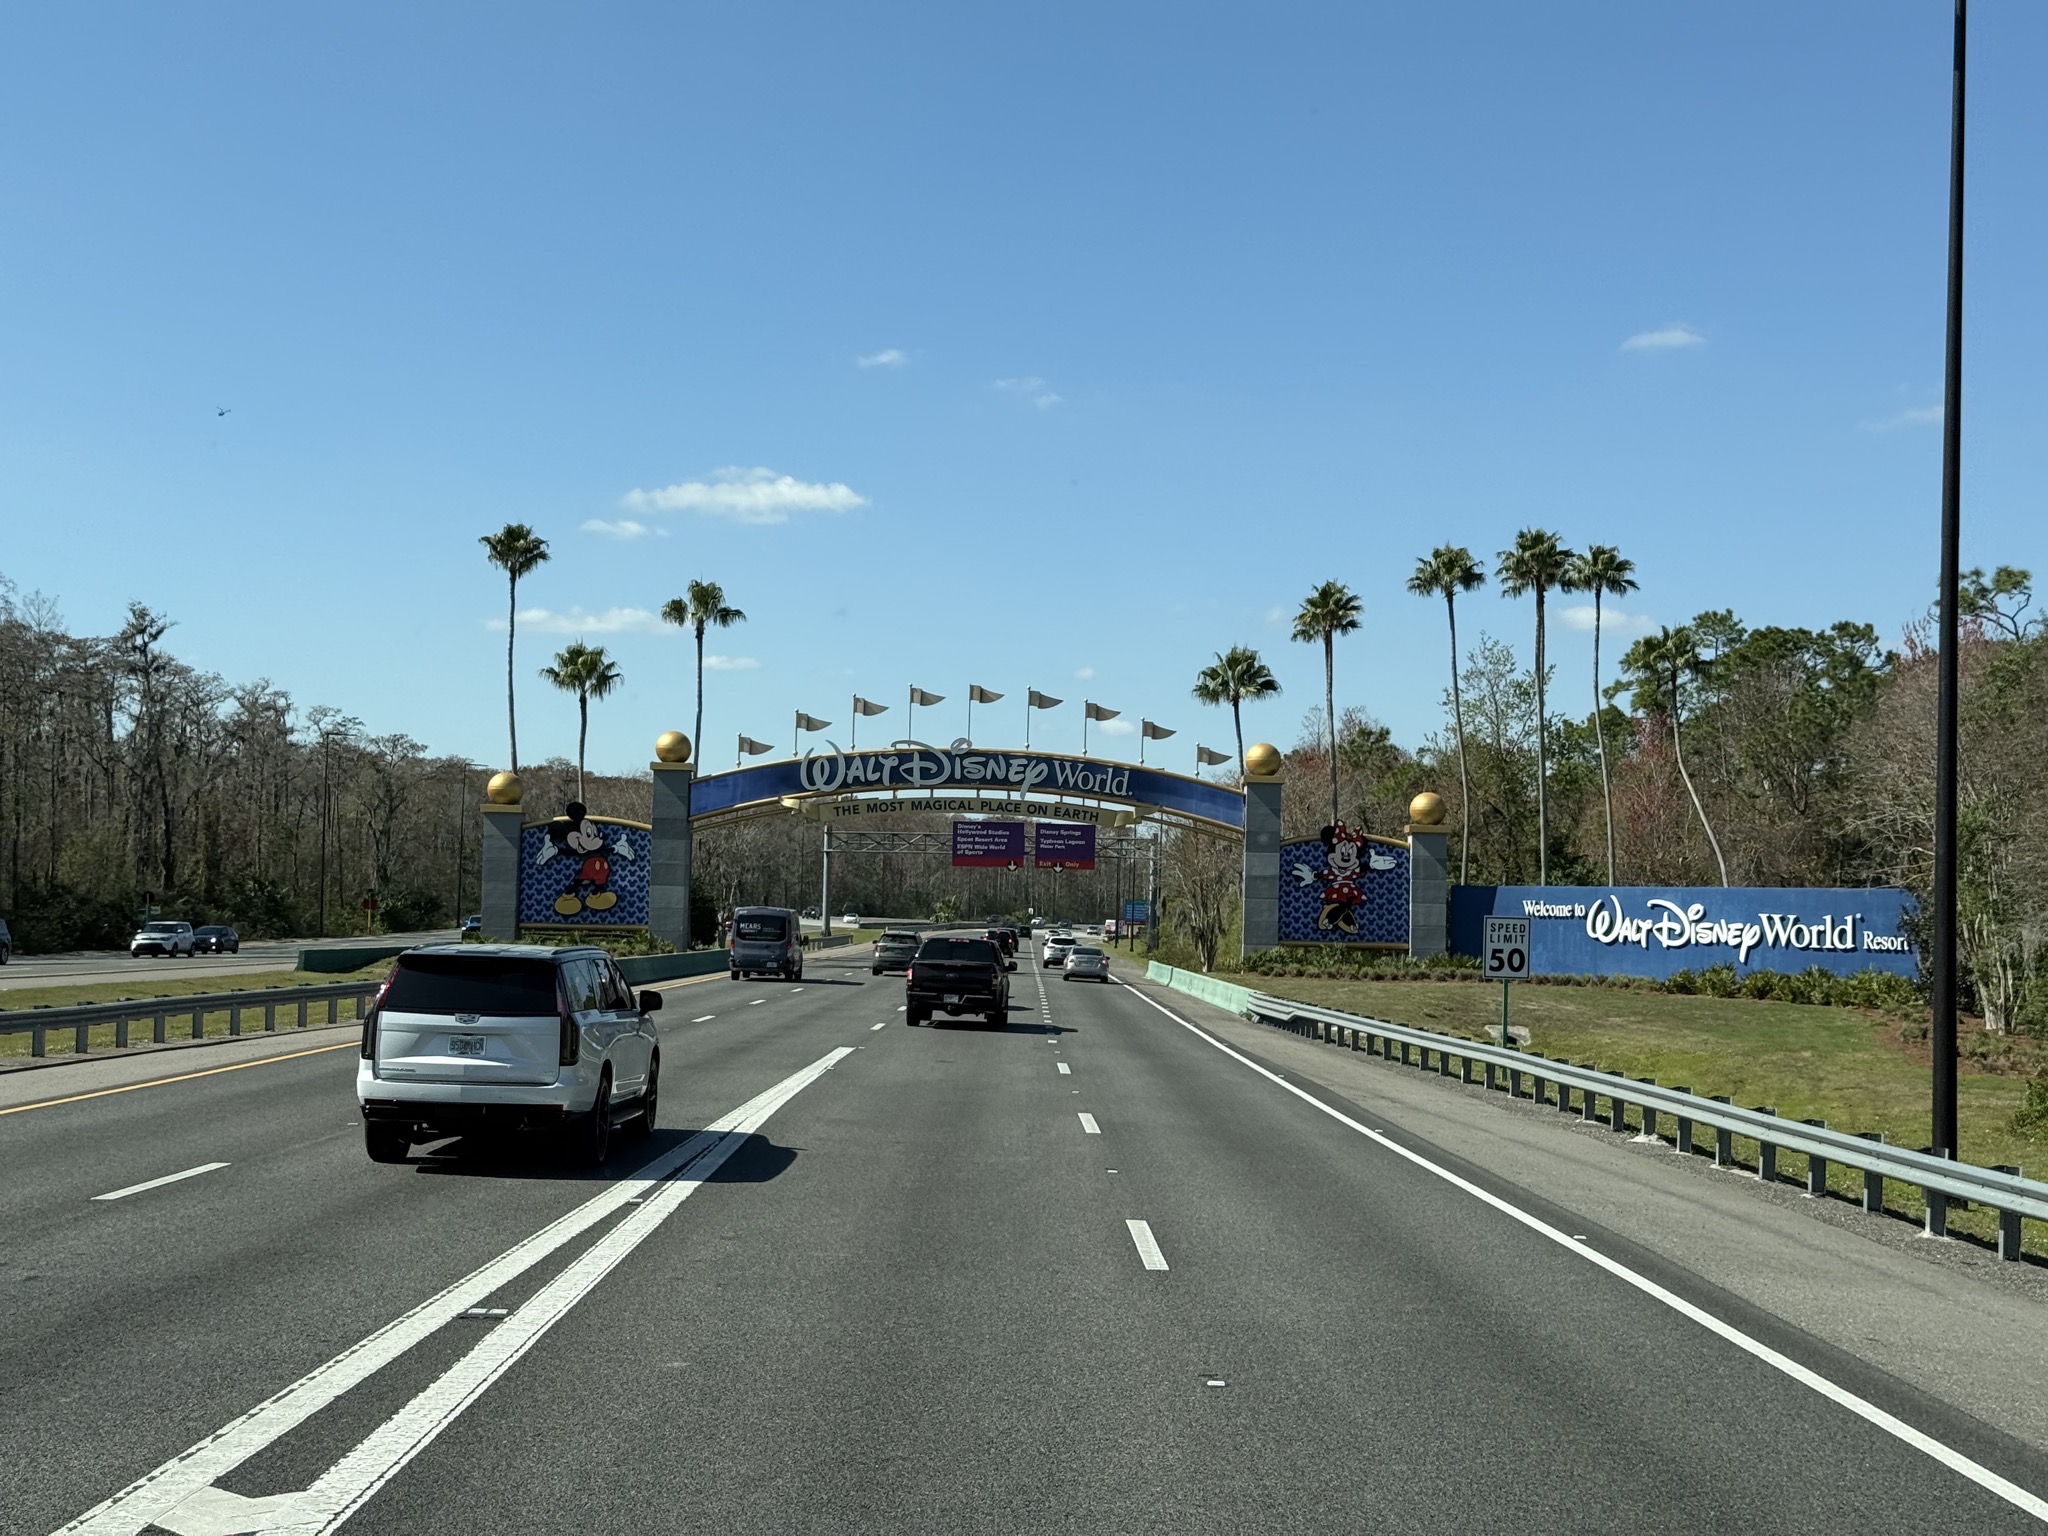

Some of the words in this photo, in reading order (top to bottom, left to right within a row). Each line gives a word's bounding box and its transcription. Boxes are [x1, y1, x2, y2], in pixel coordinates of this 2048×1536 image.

[833, 804, 860, 817] THE
[866, 801, 904, 813] MOST
[911, 800, 974, 811] MAGICAL
[980, 801, 1021, 813] PLACE
[1027, 804, 1047, 817] ON
[1053, 807, 1099, 822] EARTH
[957, 823, 981, 831] Disney's
[1065, 861, 1080, 869] Only
[1522, 900, 1572, 917] Welcome
[1574, 903, 1586, 917] to
[1490, 923, 1526, 934] SPEED
[1490, 934, 1526, 944] LIMIT
[1489, 948, 1526, 972] 50
